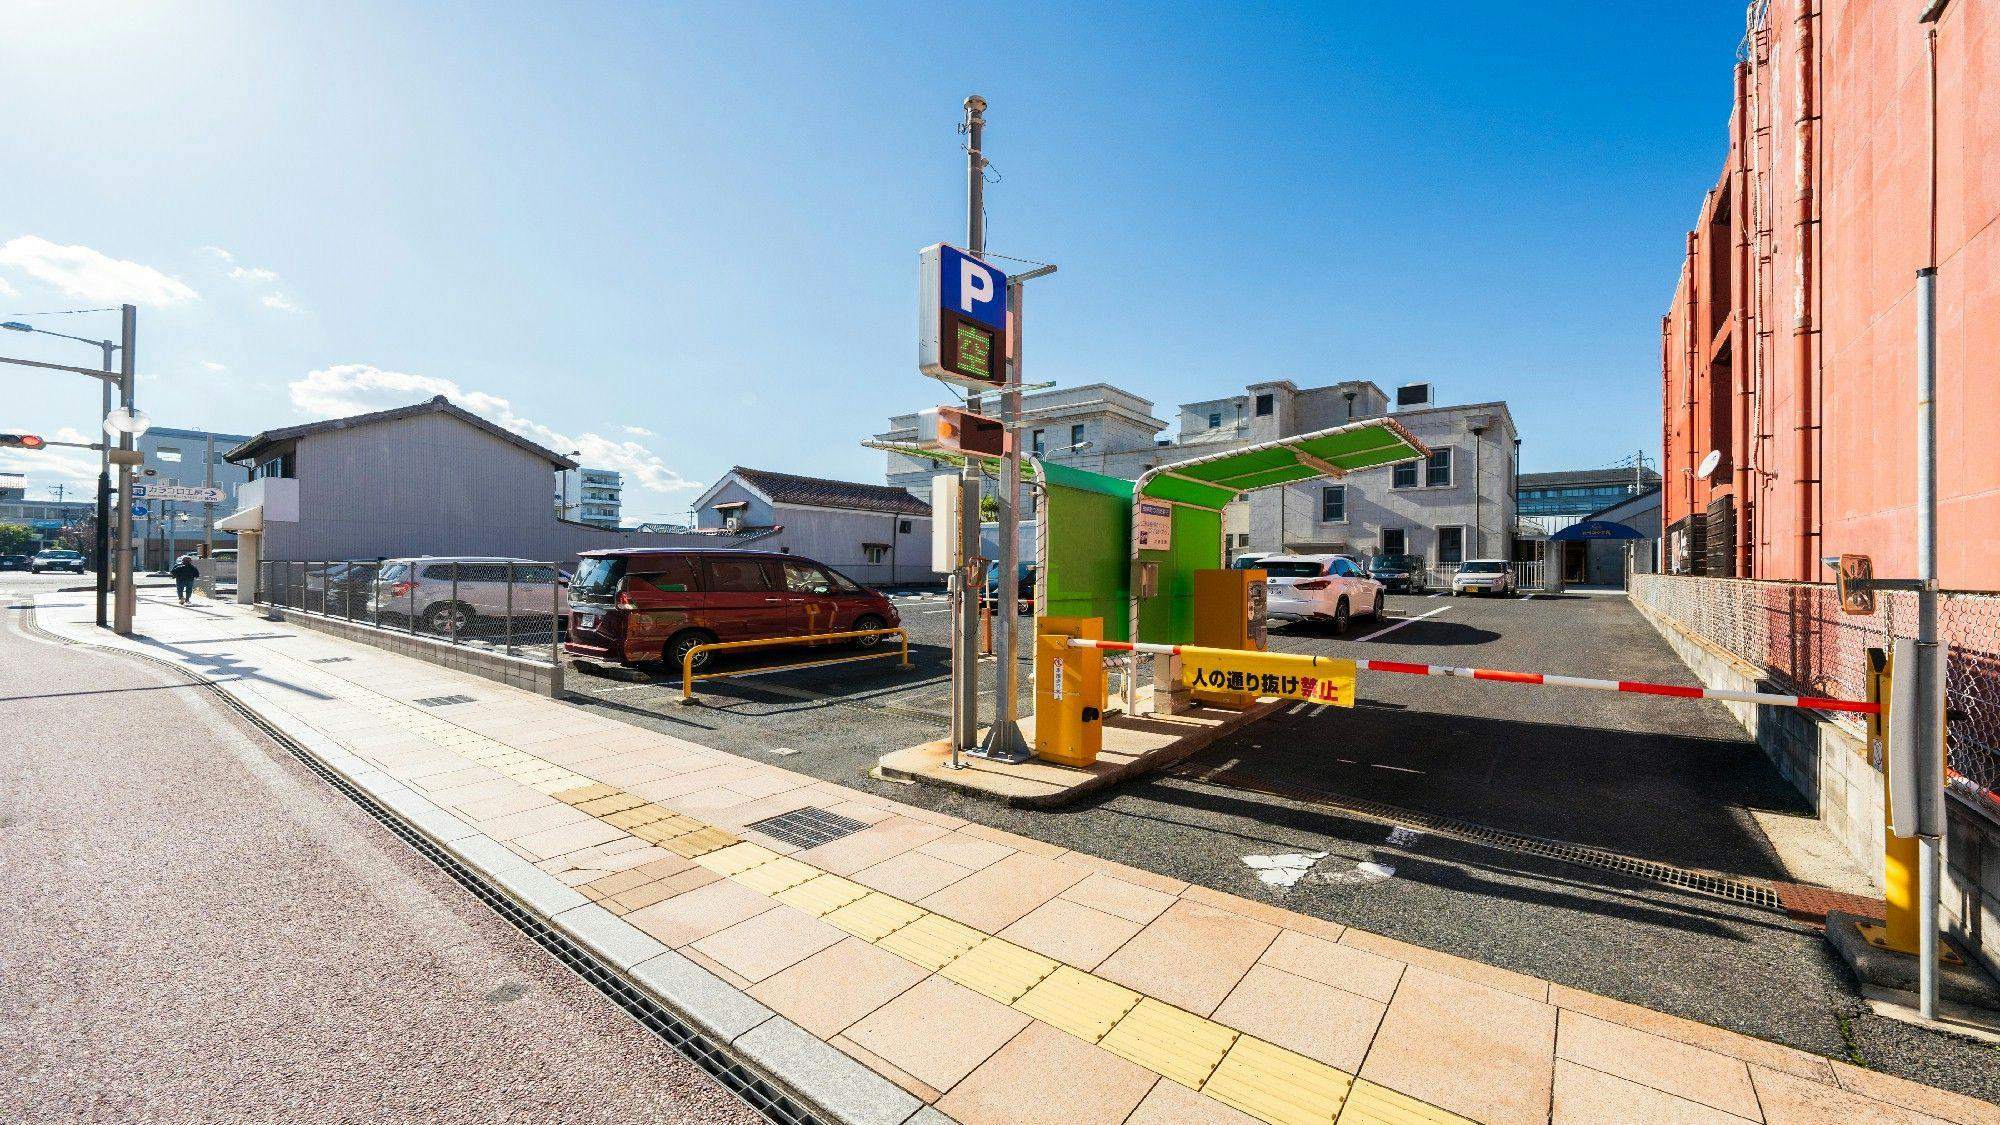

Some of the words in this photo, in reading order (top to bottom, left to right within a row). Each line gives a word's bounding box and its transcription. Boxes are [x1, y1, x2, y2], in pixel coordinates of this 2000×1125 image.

[960, 257, 994, 313] P
[957, 327, 990, 377] 空
[1192, 668, 1338, 702] 人の通り抜け禁止
